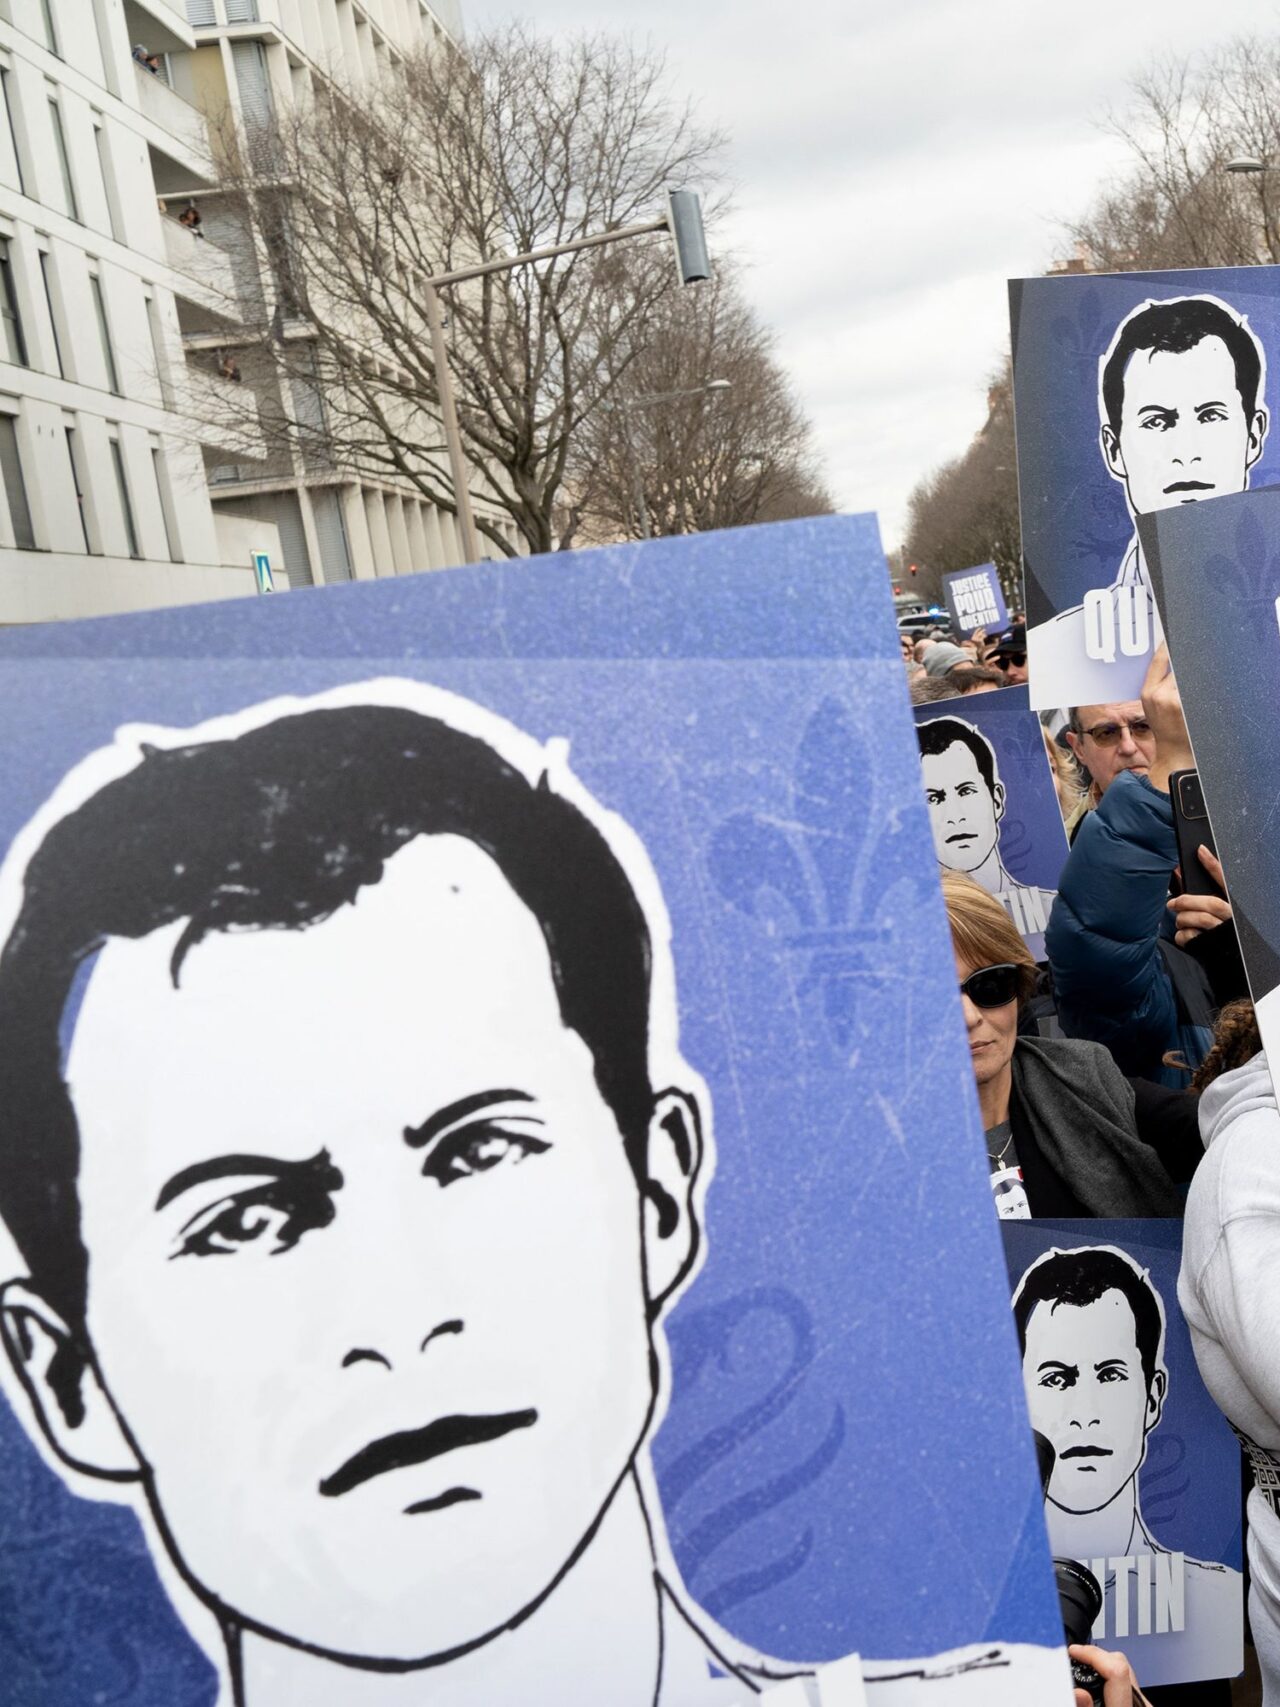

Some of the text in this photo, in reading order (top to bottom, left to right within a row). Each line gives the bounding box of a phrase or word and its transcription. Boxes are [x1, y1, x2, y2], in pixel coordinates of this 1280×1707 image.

[949, 572, 992, 596] JUSTICE
[953, 588, 996, 617] POUR
[959, 608, 1000, 631] QUENTIN
